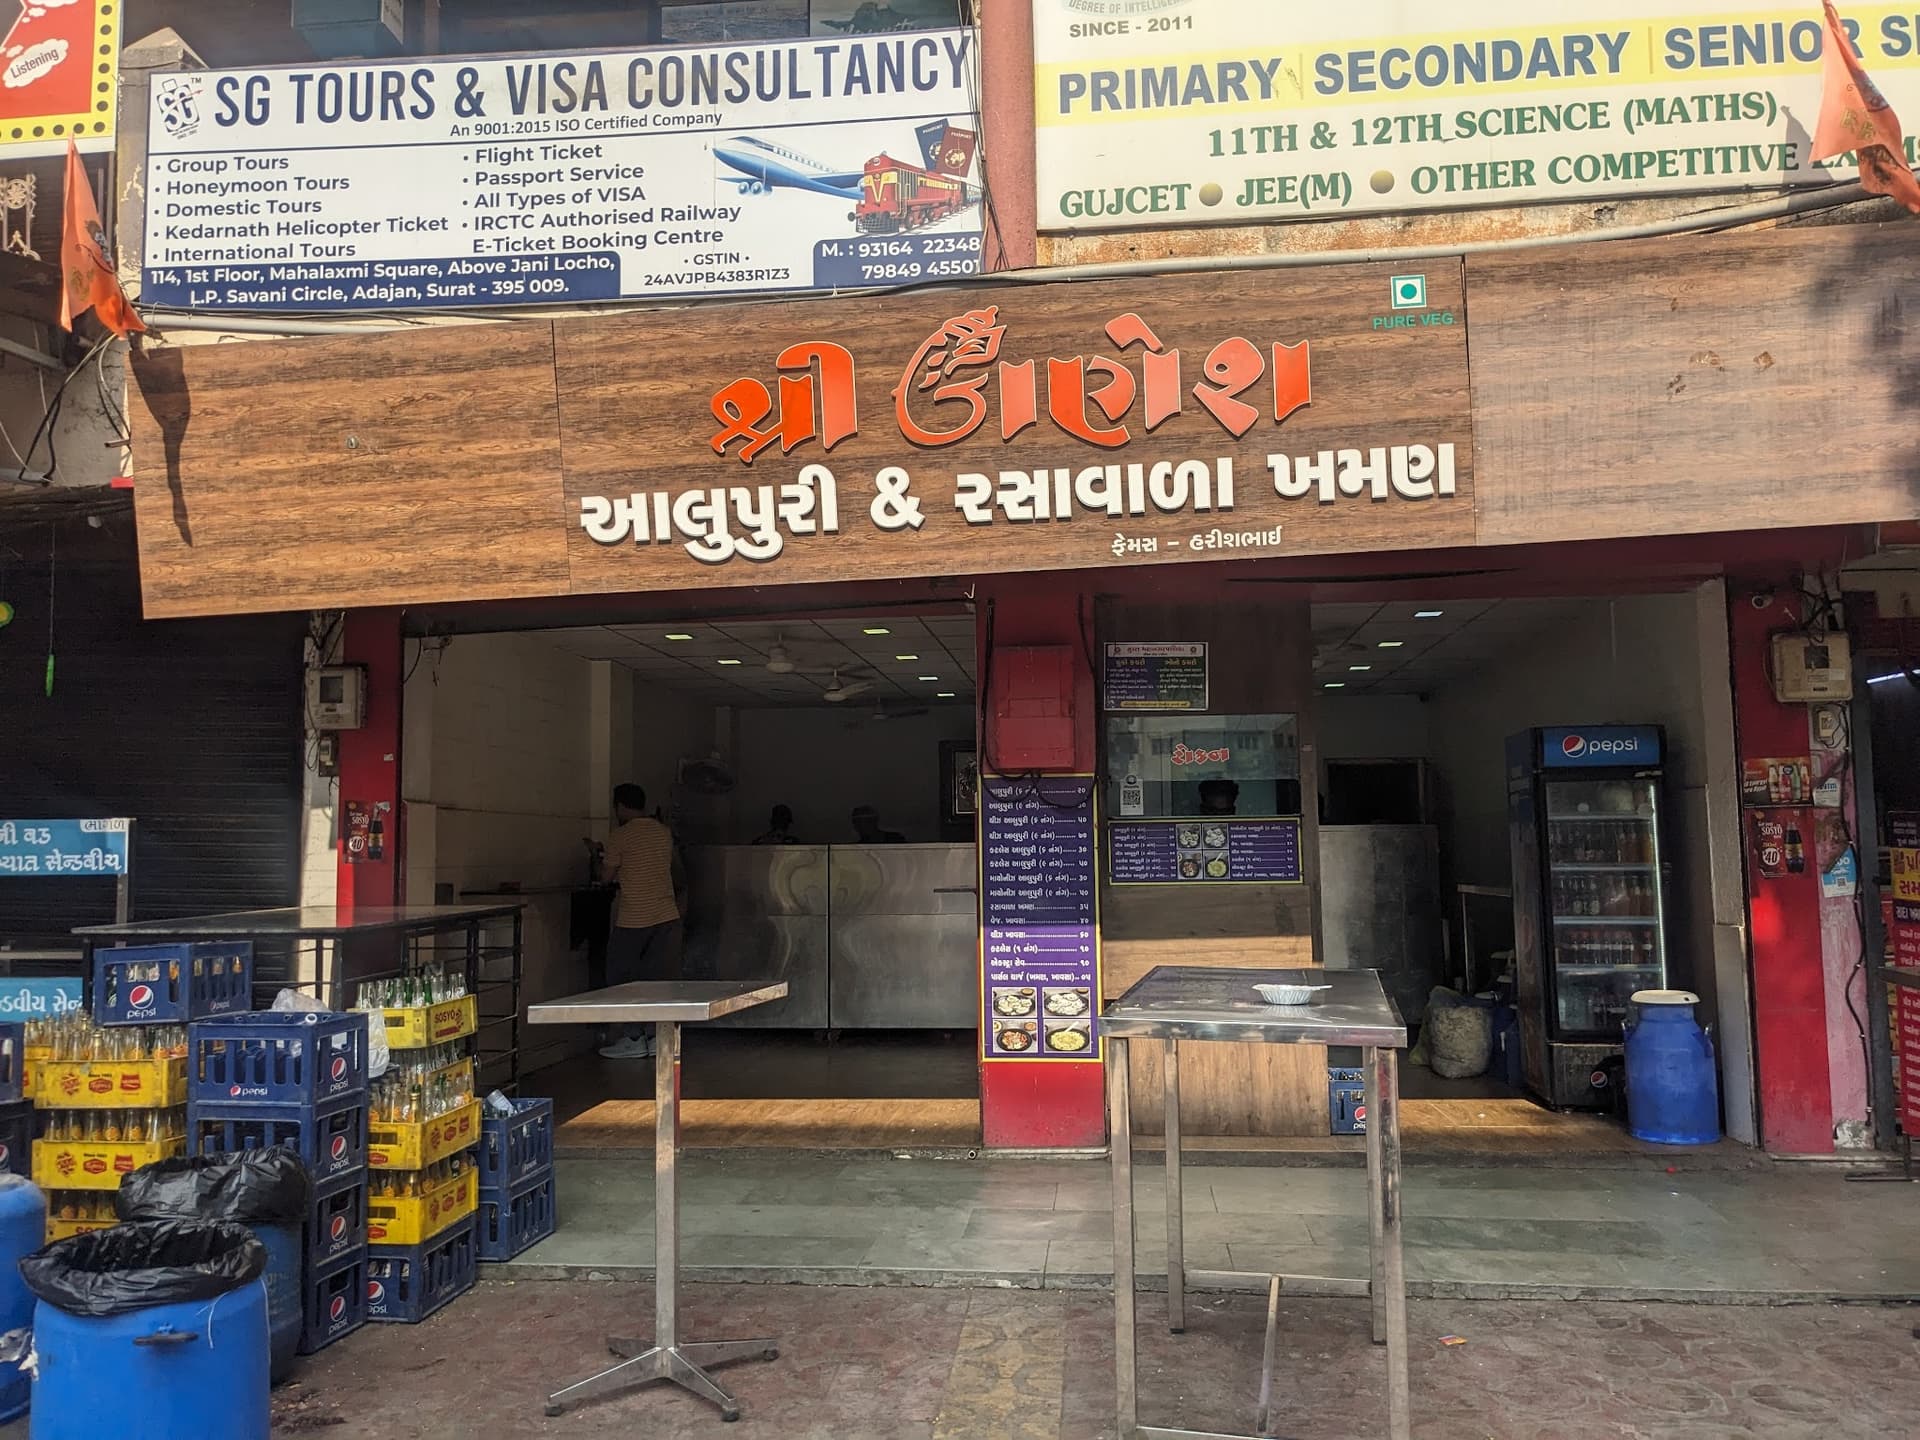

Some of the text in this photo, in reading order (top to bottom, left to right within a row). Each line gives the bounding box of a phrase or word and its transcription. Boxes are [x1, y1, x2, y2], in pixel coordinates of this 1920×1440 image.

[1109, 3, 1121, 14] OF
[1069, 15, 1193, 38] SINCE 2011
[10, 49, 59, 78] Listening
[1058, 57, 1283, 115] PRIMARY
[1314, 31, 1631, 96] SECONDARY
[215, 36, 971, 127] SG TOURS & VISA CONSULTANCY
[450, 112, 722, 138] An 9001:2015 ISO Certified Company
[1209, 91, 1777, 157] 11TH & 12TH SCIENCE (MATHS)
[475, 142, 603, 165] Flight Ticket
[166, 156, 289, 177] Group Tours
[475, 163, 645, 188] Passport Service
[166, 175, 350, 198] Honeymoon Tours
[1060, 183, 1192, 218] GUJCET
[1236, 171, 1352, 209] JEE(M)
[1410, 158, 1535, 195] OTHER
[1547, 142, 1799, 184] COMPETITIVE
[165, 198, 323, 218] Domestic Tours
[474, 186, 646, 212] All Types of VISA
[165, 215, 449, 240] Kedarnath Helicopter Ticket
[474, 204, 742, 231] IRCTC Authorised Railway
[164, 242, 356, 262] International Tours
[472, 227, 724, 254] E-Ticket Booking Centre
[858, 239, 913, 257] 93164
[922, 235, 981, 254] 22348
[693, 251, 741, 266] GSTIN
[861, 258, 981, 281] 79849 45501
[150, 254, 615, 287] 114, 1st Floor, Mahalaxmi Square, Above Jani Locho,
[644, 266, 791, 287] 24AVJPB4383R1Z3
[190, 276, 569, 305] L.P. Savani Circle, Adajan, Surat 395 009.
[1372, 314, 1417, 331] PURE
[710, 305, 1312, 464] શ્રી ગણેશ
[580, 442, 1456, 563] આલુપુરી & રસાવાળા ખમણ
[1110, 525, 1284, 556] ફેમસ હરીશભાઈ
[1589, 737, 1638, 754] pepsi
[126, 1008, 157, 1019] pepsi
[329, 1078, 349, 1094] pepsi
[329, 1157, 350, 1173] pepsi
[329, 1236, 349, 1252] pepsi
[328, 1317, 348, 1336] pepsi
